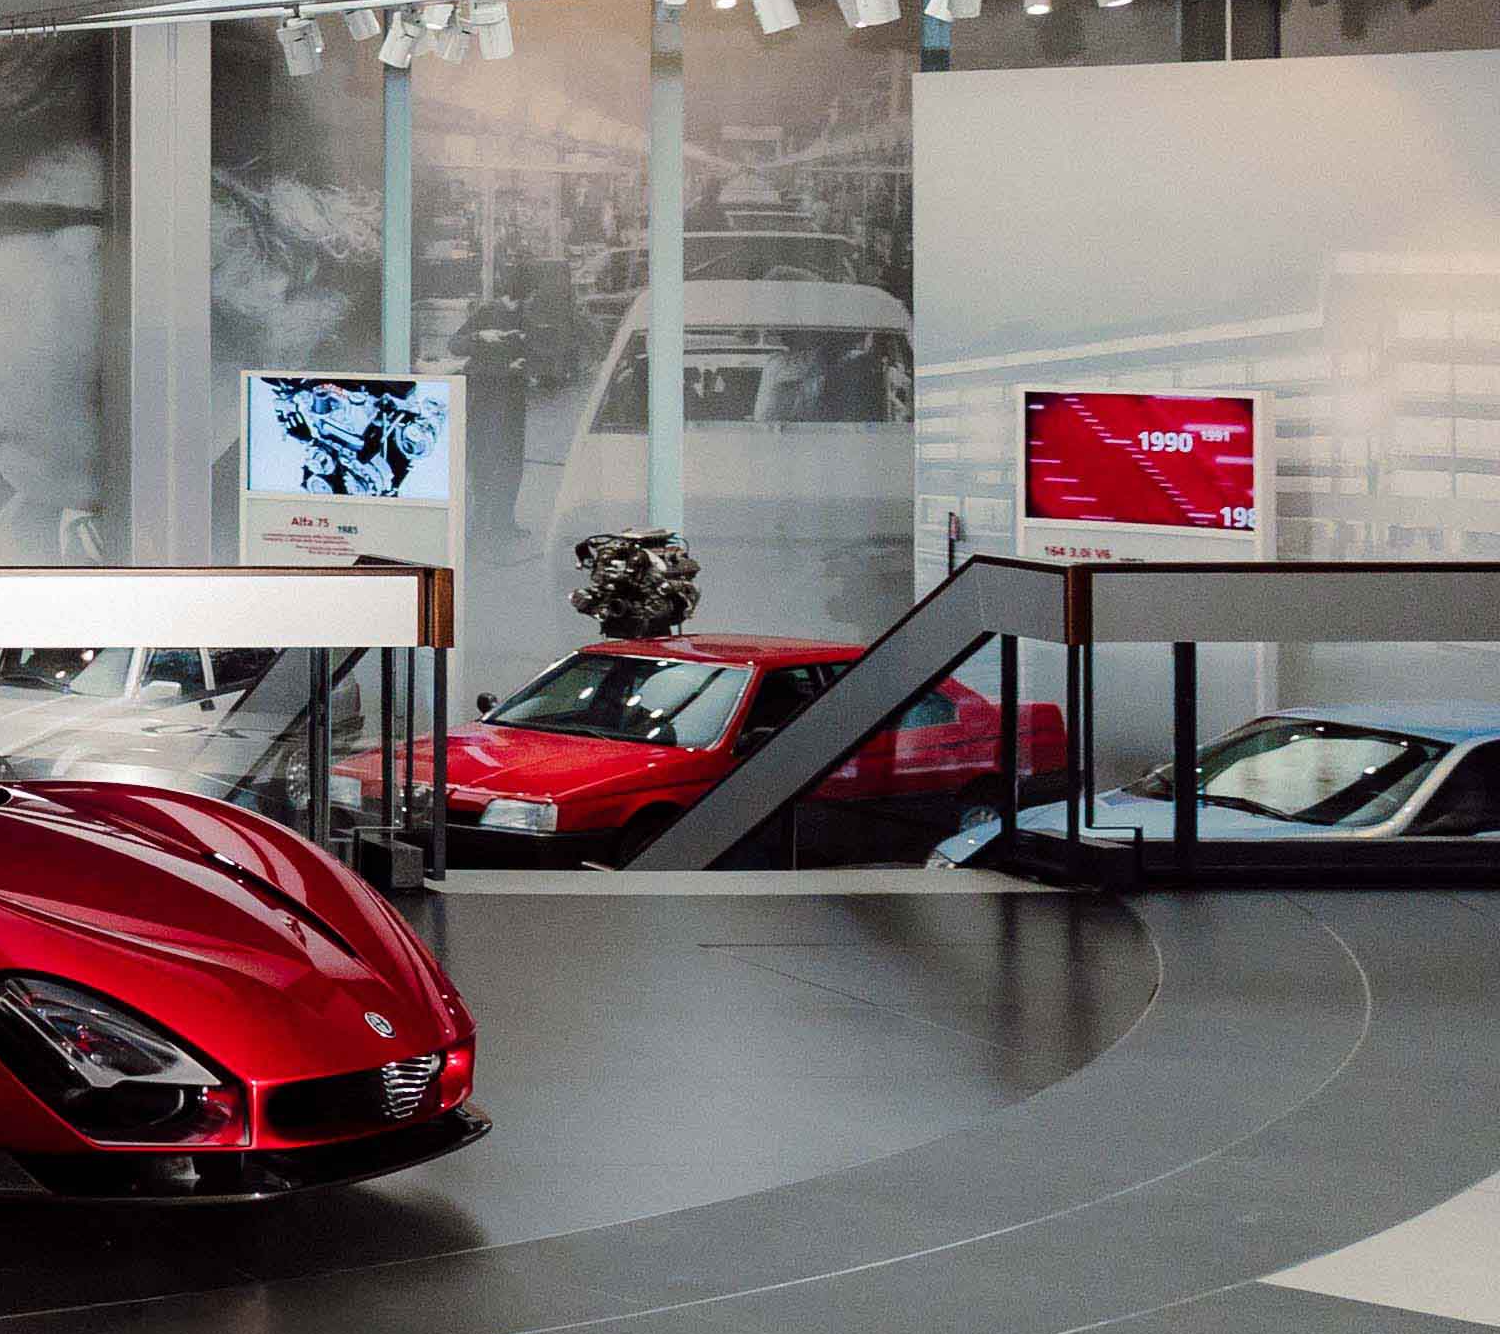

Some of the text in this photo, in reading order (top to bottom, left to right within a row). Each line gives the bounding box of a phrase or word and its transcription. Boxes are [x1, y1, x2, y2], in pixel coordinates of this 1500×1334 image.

[1137, 431, 1193, 454] 1990
[291, 516, 313, 527] Alfa
[318, 517, 330, 528] 75
